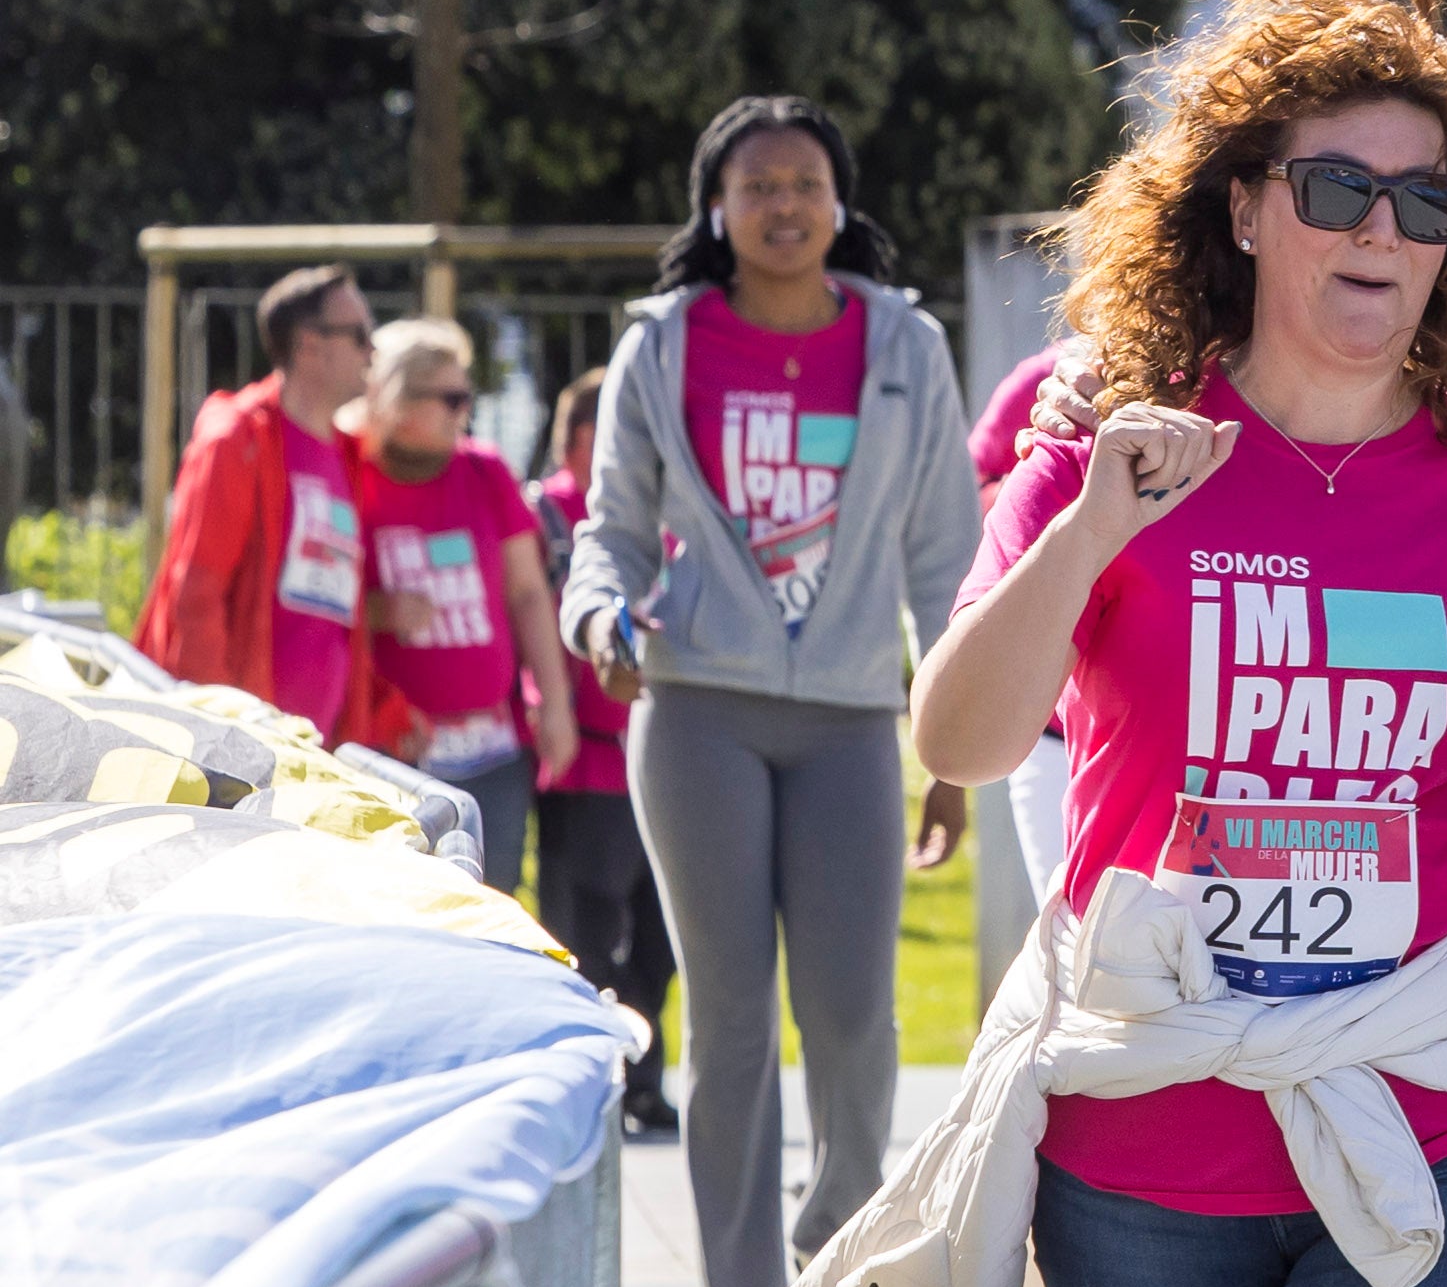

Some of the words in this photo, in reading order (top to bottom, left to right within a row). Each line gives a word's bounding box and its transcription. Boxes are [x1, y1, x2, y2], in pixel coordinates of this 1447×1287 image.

[1190, 550, 1310, 580] SOMOS
[1225, 817, 1254, 849] VI
[1260, 818, 1380, 854] MARCHA
[1257, 850, 1274, 860] DE
[1276, 850, 1288, 860] LA
[1289, 850, 1380, 883] MUJER
[1201, 884, 1355, 956] 242
